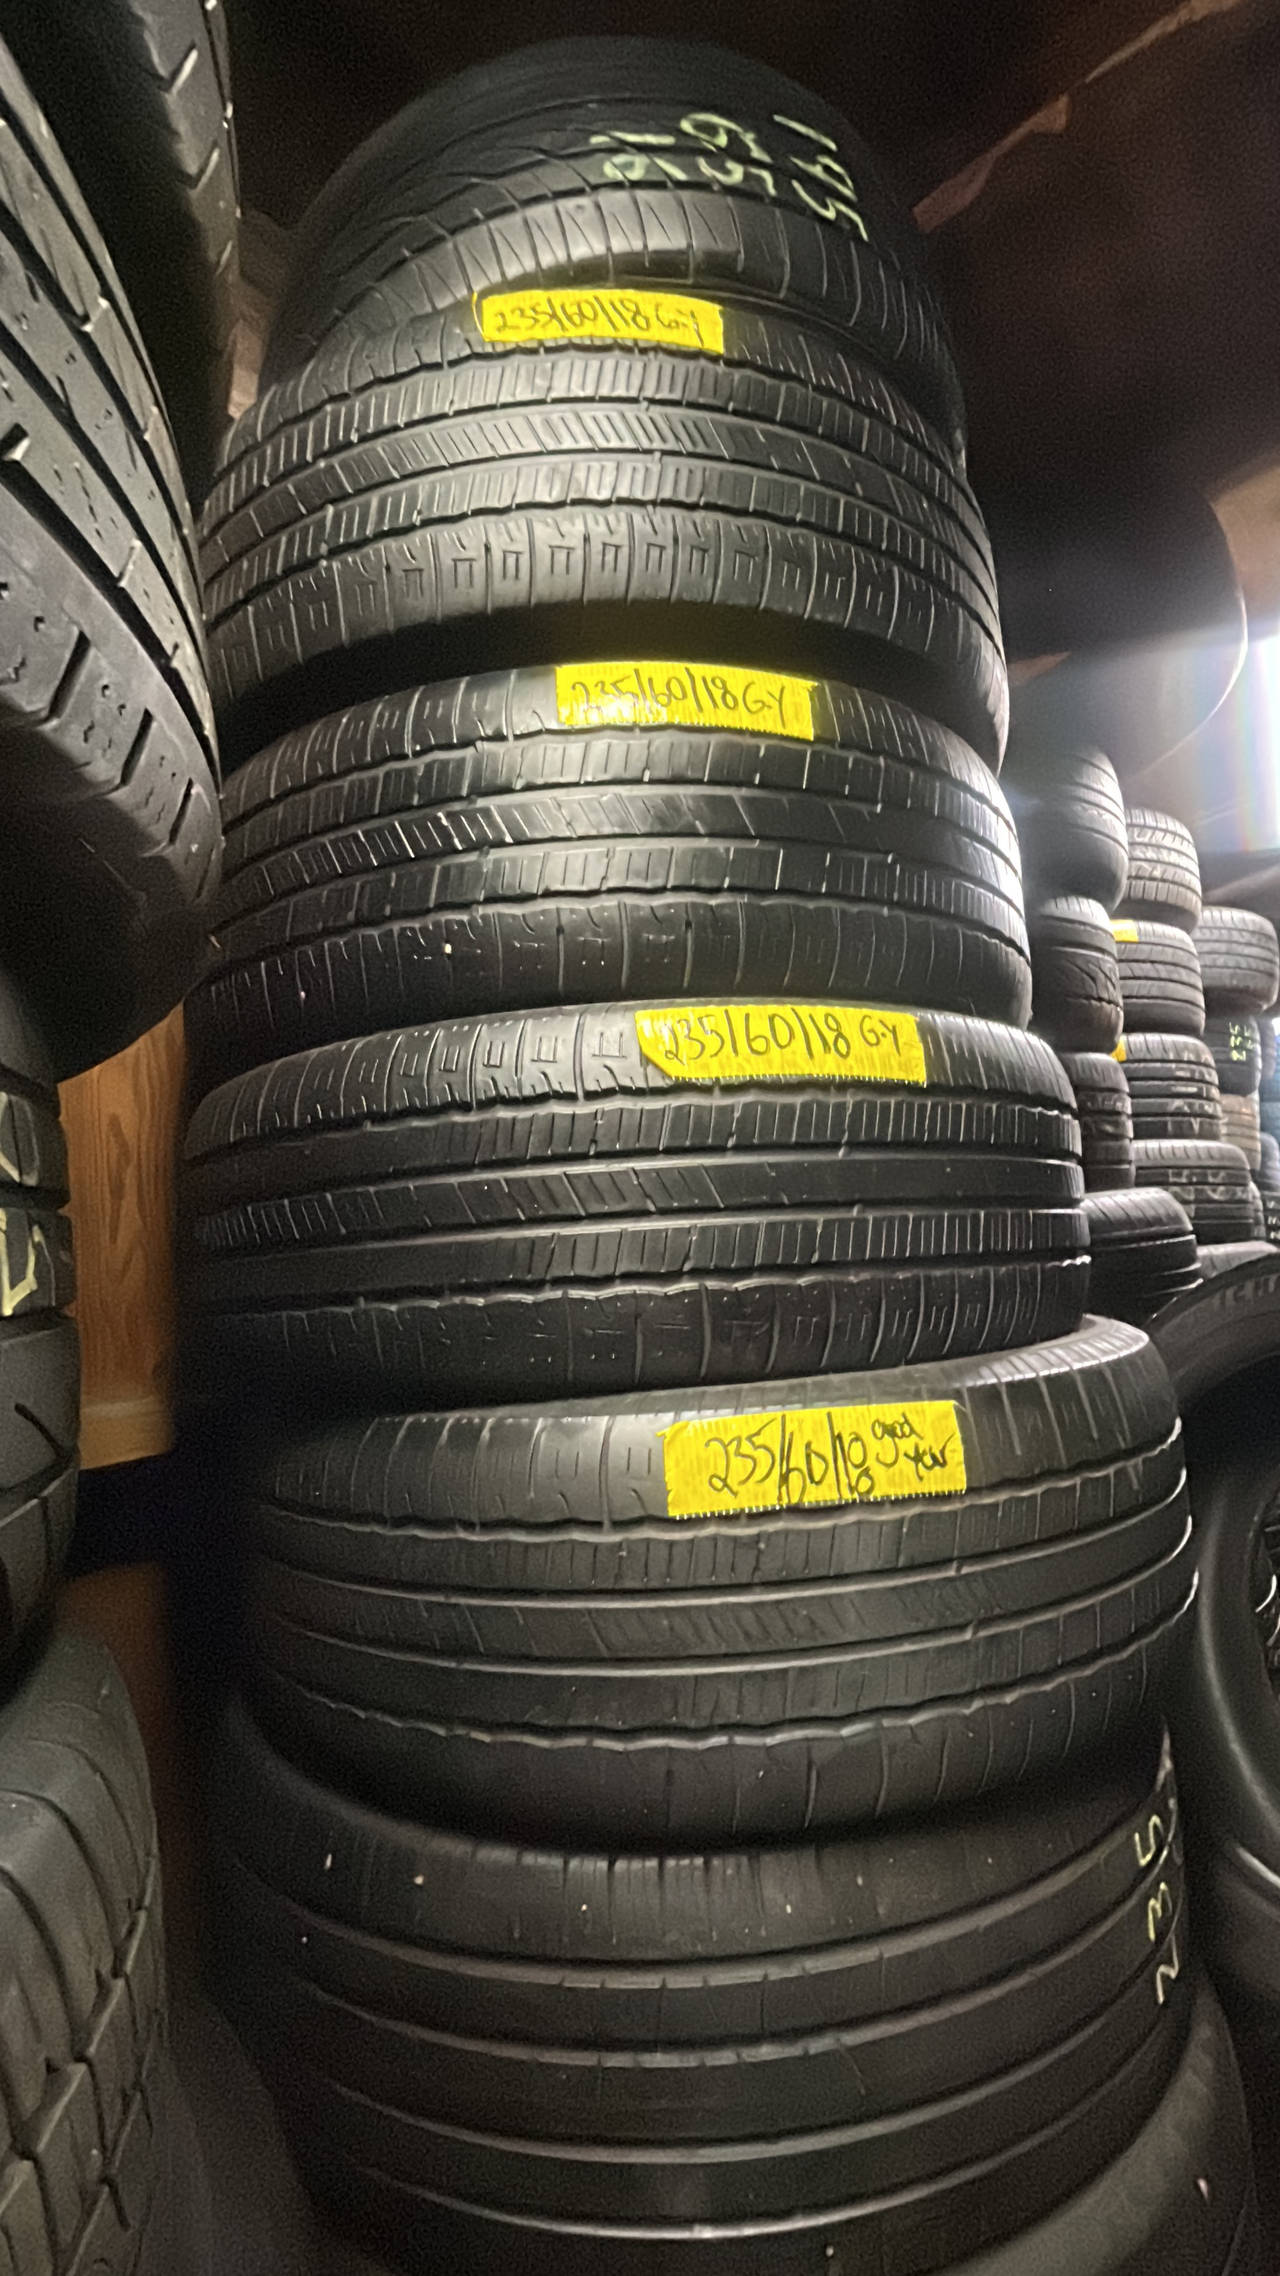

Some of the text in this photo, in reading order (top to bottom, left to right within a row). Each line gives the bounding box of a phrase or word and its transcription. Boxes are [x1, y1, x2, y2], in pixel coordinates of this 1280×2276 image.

[772, 114, 869, 242] 195
[493, 295, 651, 333] 235/60/18
[571, 667, 739, 714] 235/60/18
[664, 1007, 851, 1066] 235/60/18
[705, 1411, 875, 1503] 235/60/18
[1134, 1814, 1180, 2006] 235
